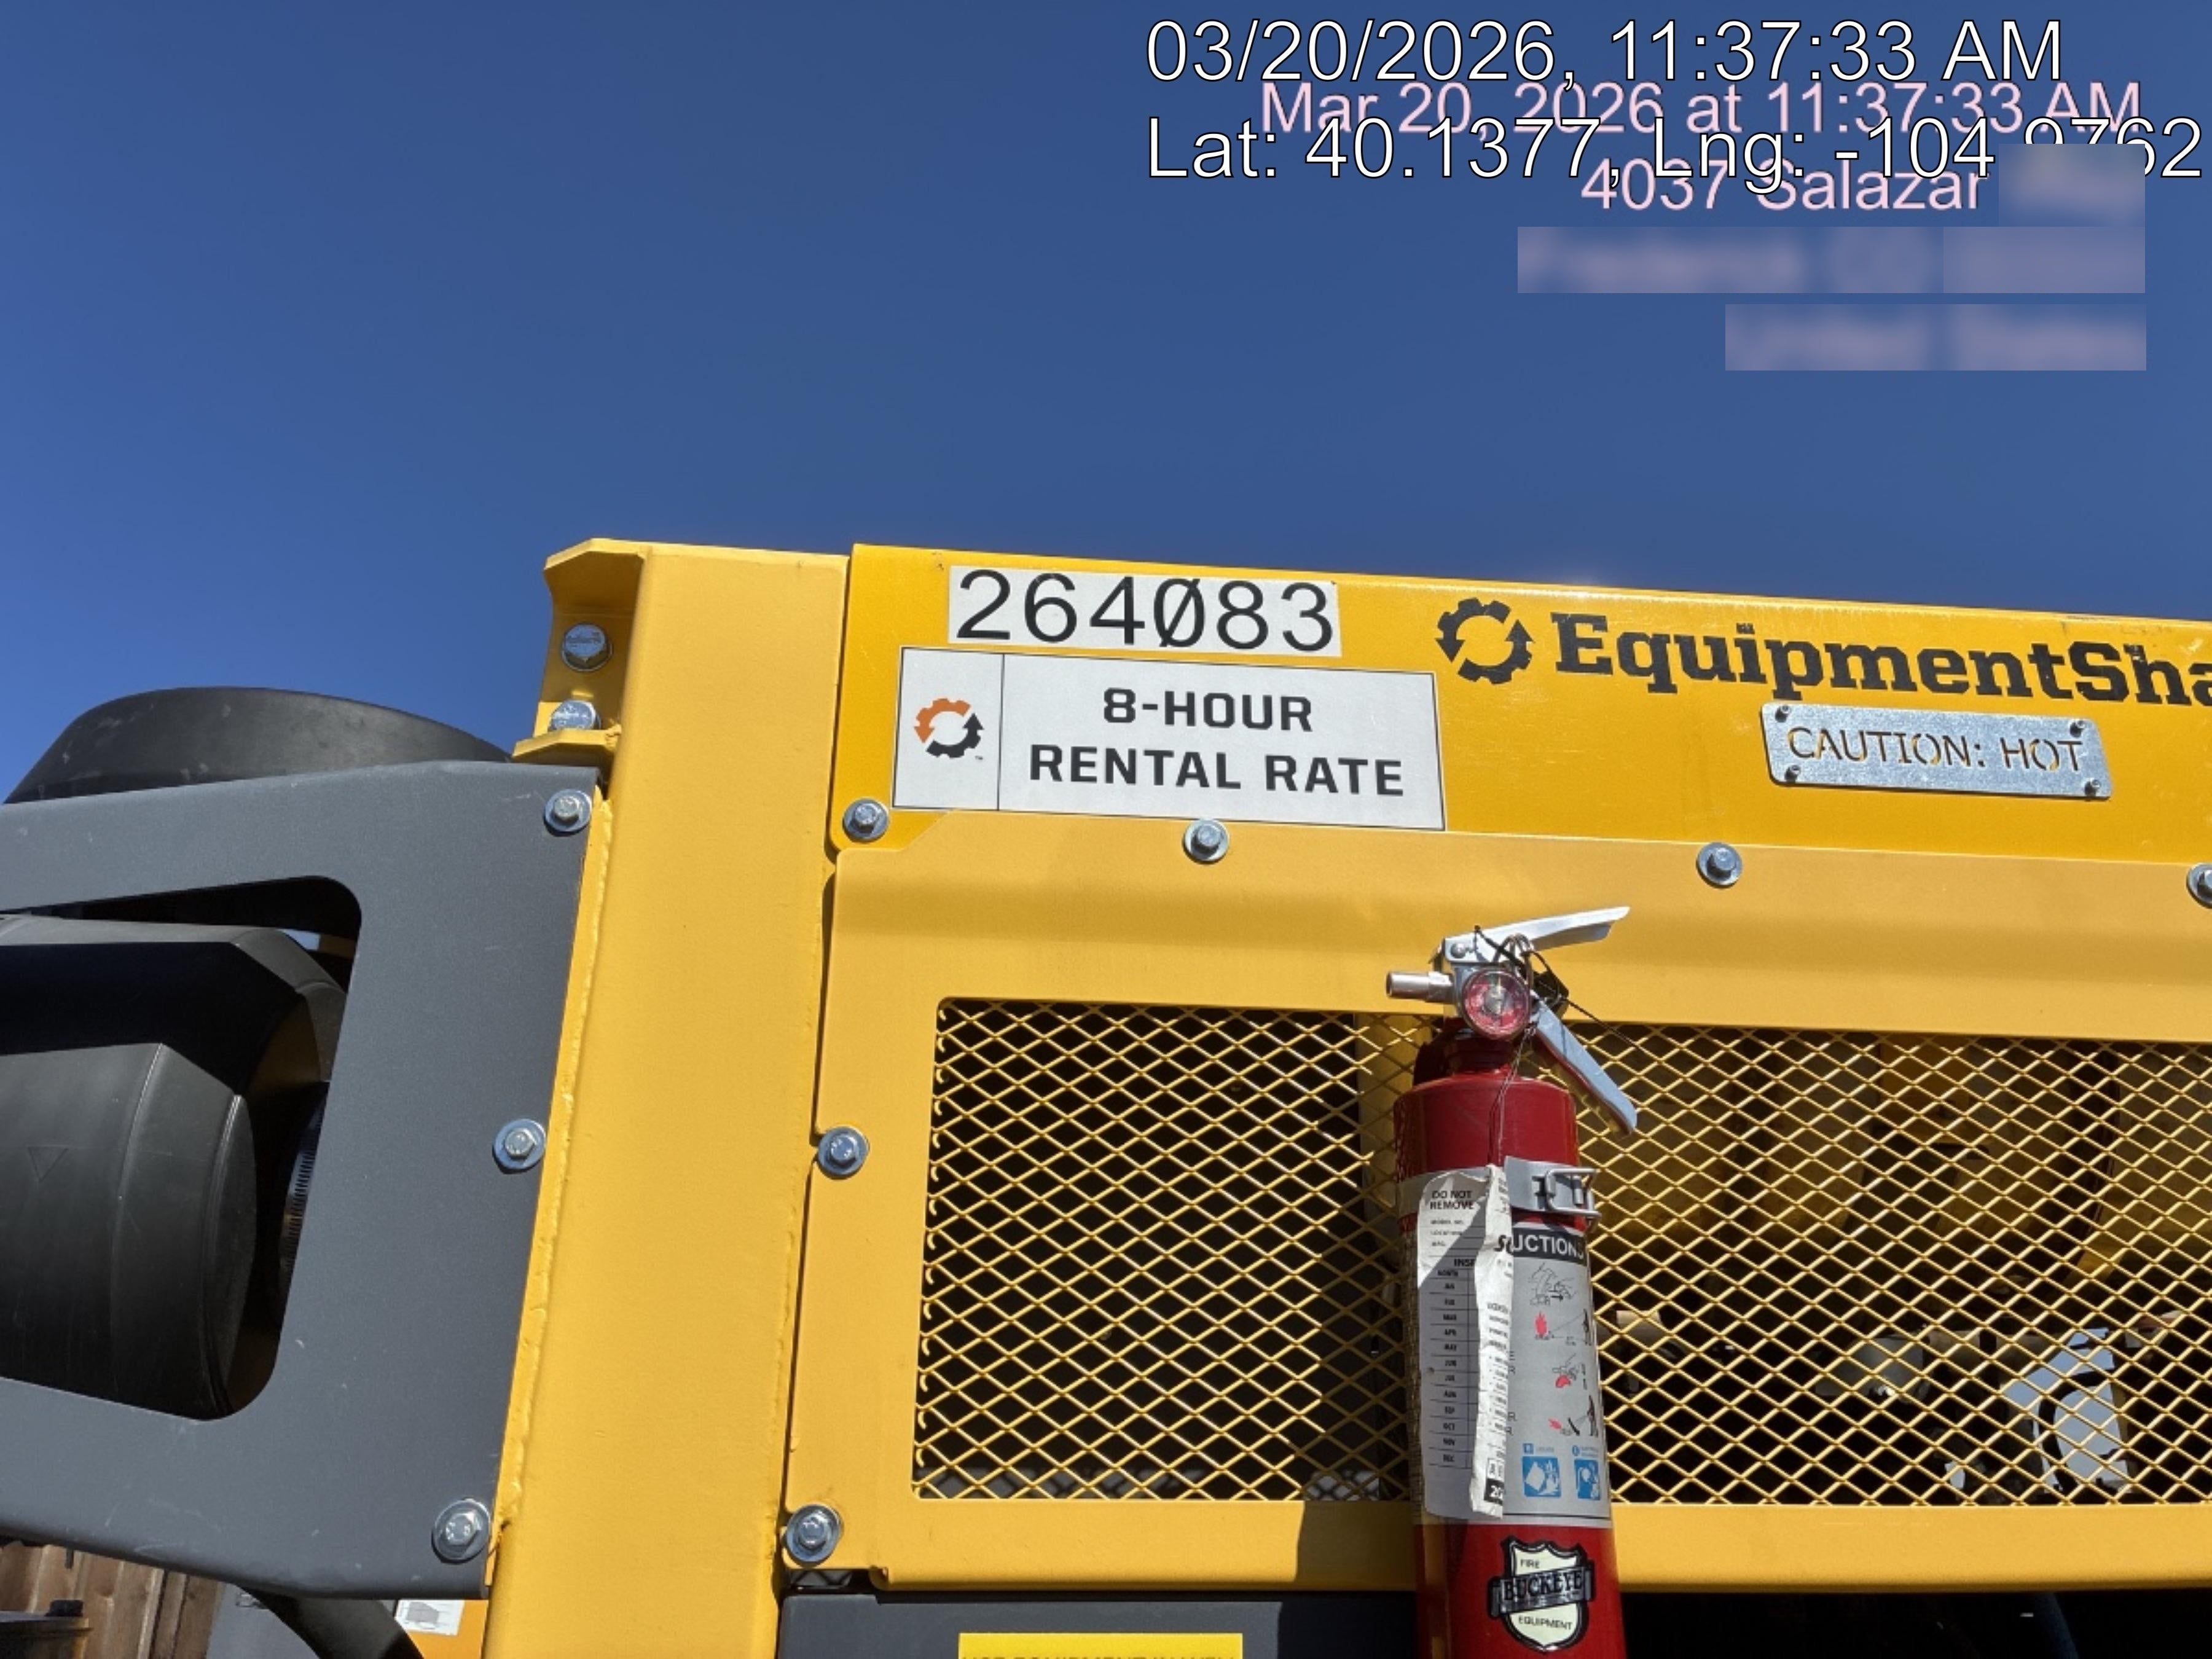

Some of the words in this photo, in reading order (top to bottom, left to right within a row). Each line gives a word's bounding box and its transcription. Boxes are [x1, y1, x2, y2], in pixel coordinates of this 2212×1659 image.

[1104, 688, 1313, 732] 8-HOUR
[1788, 727, 1986, 767] CAUTION:
[2000, 737, 2082, 771] HOT
[1030, 745, 1241, 789] RENTAL
[1265, 755, 1404, 796] RATE
[1521, 1559, 1540, 1568] FIRE
[1505, 1570, 1583, 1600] BUCKEYE
[1518, 1617, 1572, 1630] EQUIPMENT
